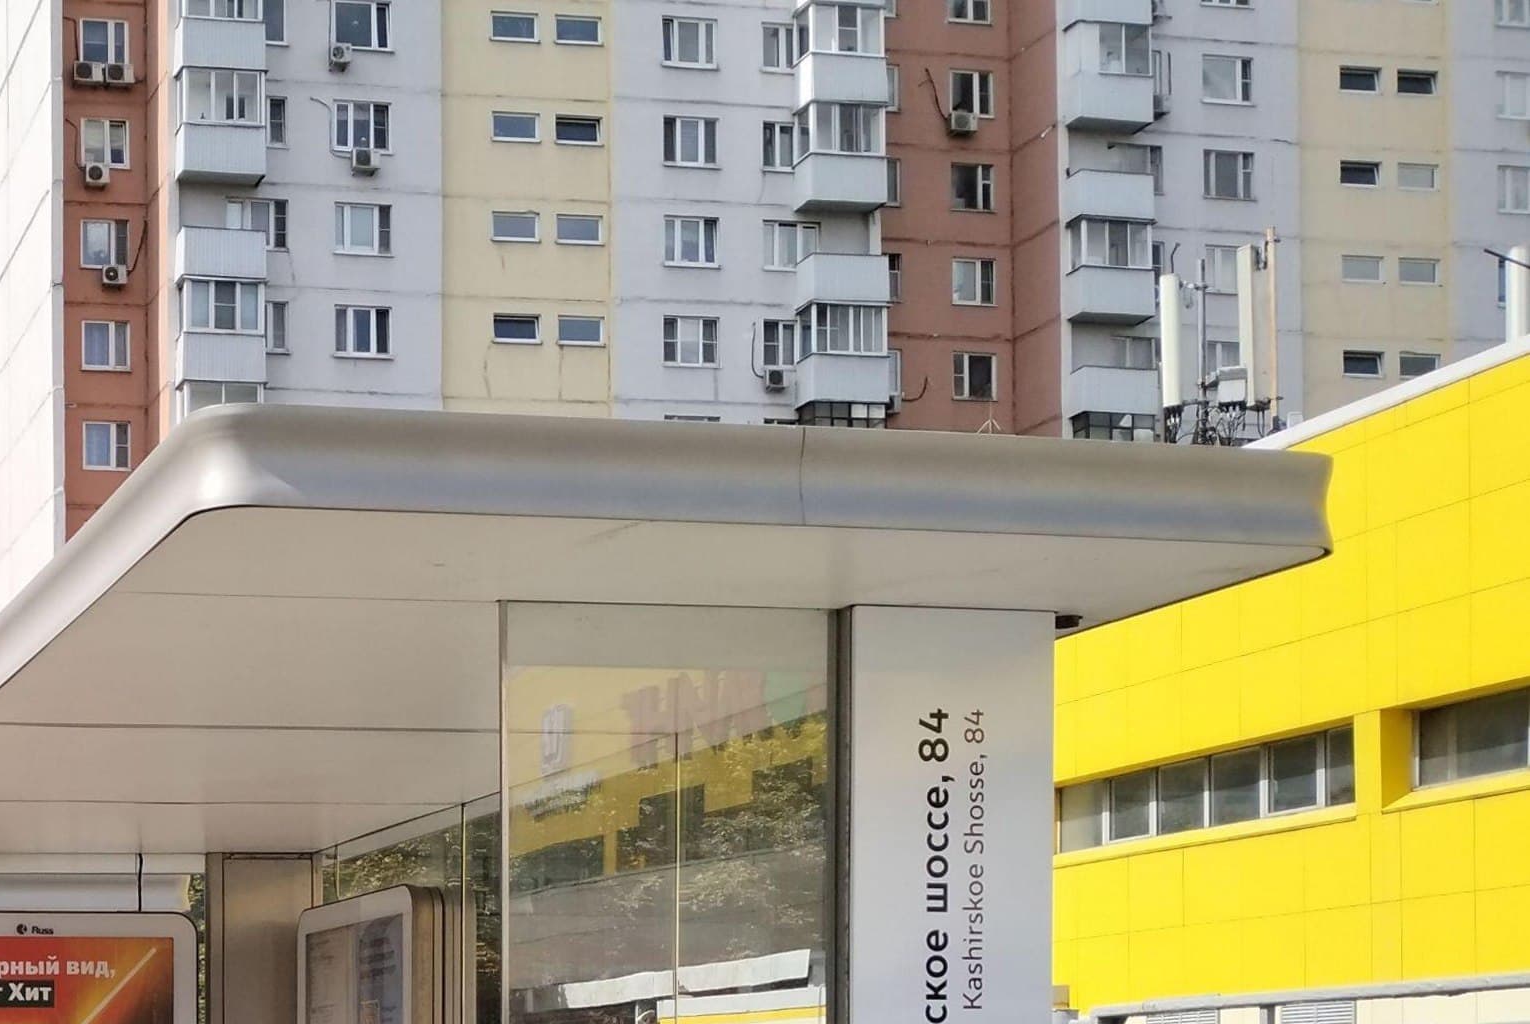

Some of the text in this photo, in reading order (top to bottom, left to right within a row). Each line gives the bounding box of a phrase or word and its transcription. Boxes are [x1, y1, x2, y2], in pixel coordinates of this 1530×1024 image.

[918, 708, 950, 763] 84
[925, 775, 955, 913] шоссе,
[962, 709, 987, 1010] Kashirskoe Shosse, 84
[7, 982, 52, 1002] Хит
[66, 960, 116, 979] вид,
